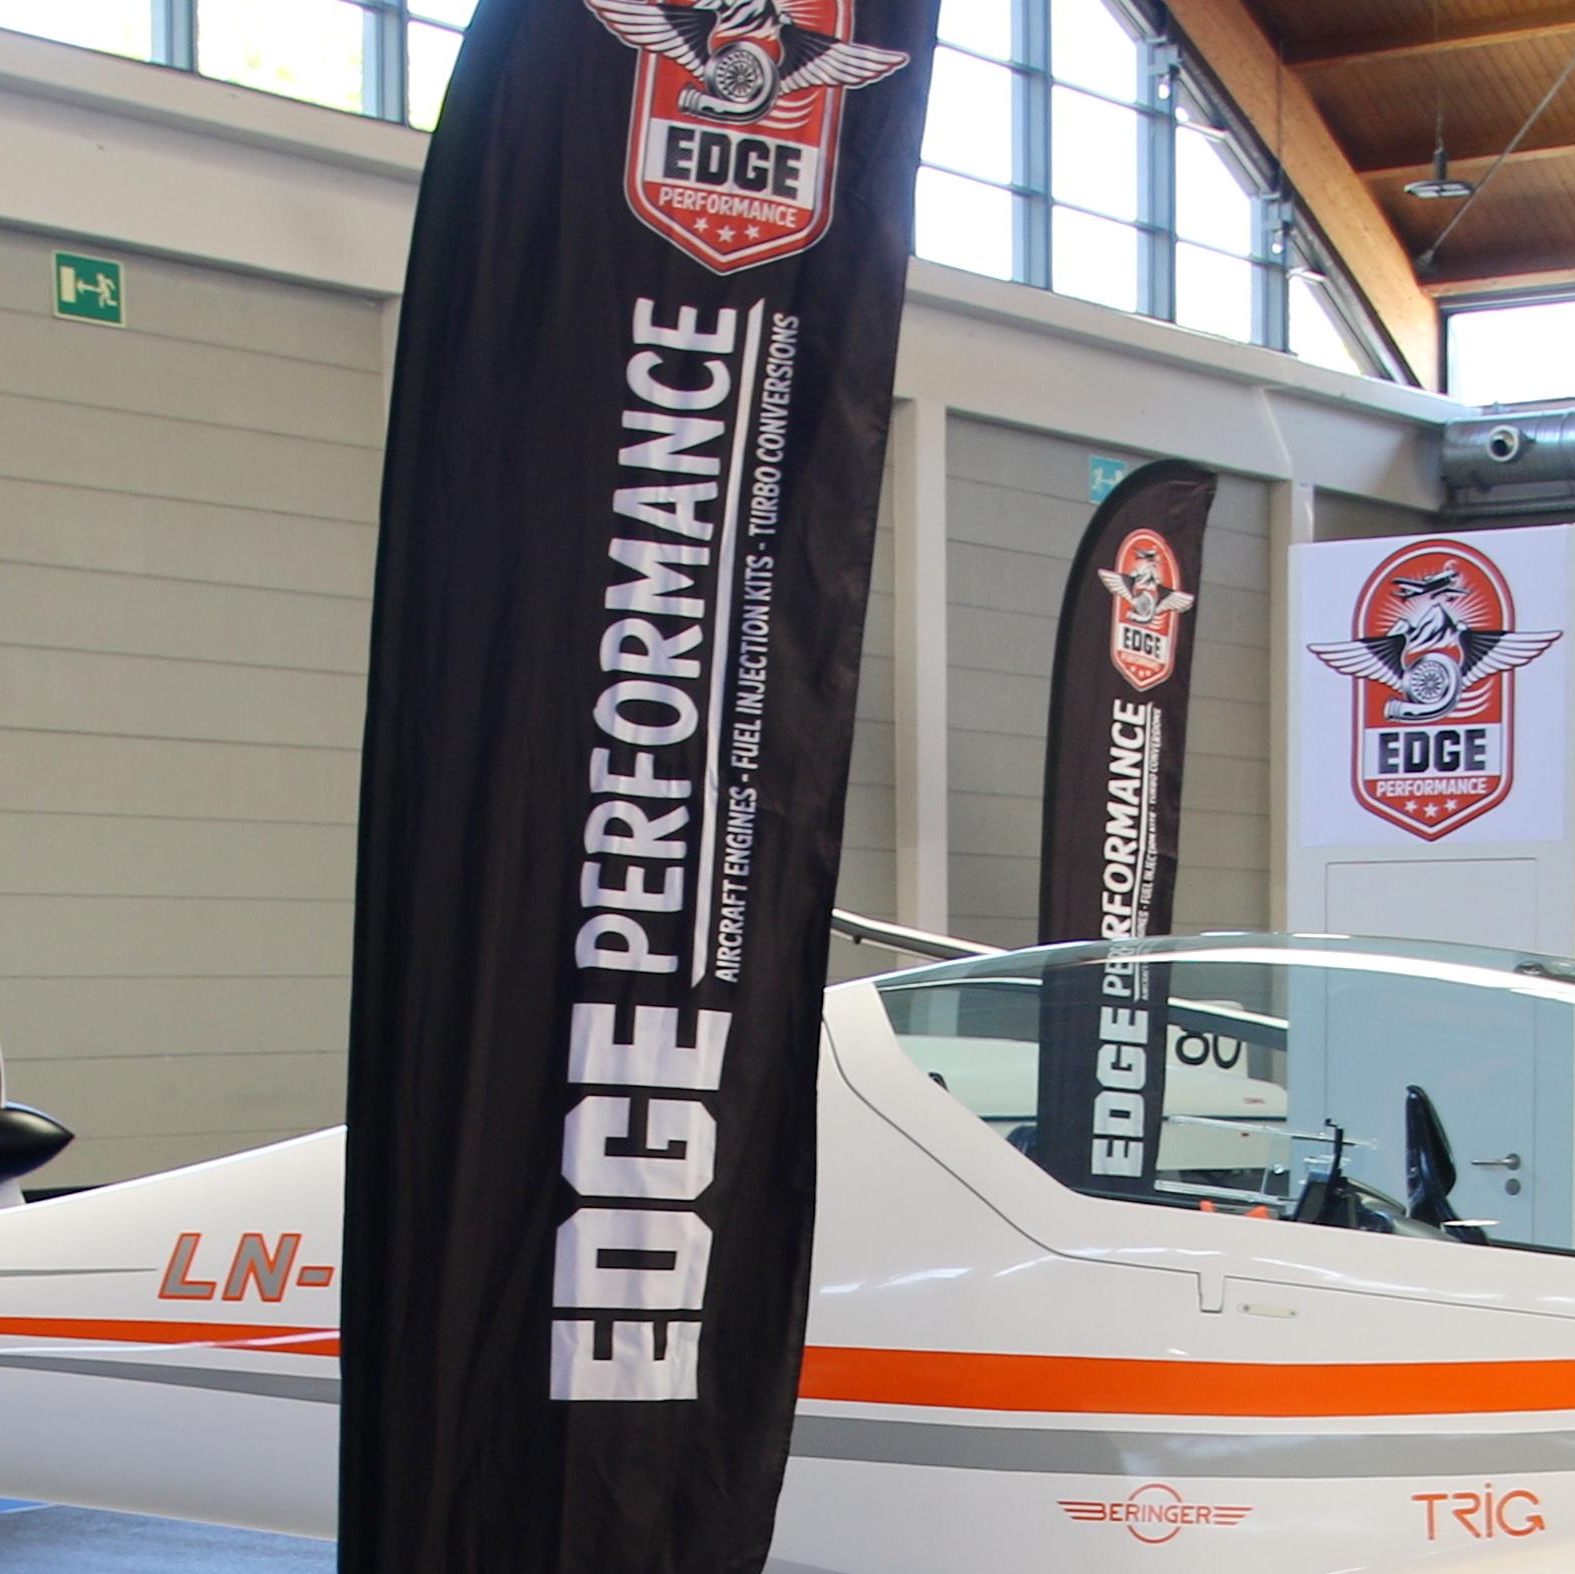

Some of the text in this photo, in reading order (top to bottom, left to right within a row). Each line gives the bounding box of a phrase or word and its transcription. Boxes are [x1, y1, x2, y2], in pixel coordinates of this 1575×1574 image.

[663, 125, 803, 200] EDGE
[659, 189, 798, 229] PERFORMANCE
[756, 312, 799, 464] CONVERSIONS
[749, 466, 781, 536] TURBO
[744, 554, 774, 600] KITS
[735, 605, 770, 716] INJECTION
[1123, 626, 1162, 659] EDGE
[731, 718, 761, 769] FUEL
[1378, 728, 1486, 774] EDGE
[1376, 777, 1487, 797] PERFORMANCE
[550, 297, 737, 1400] EDGE PERFORMANCE
[724, 786, 757, 877] ENGINES
[714, 880, 748, 983] AIRCRAFT
[1091, 1005, 1149, 1178] EDGE
[1089, 1501, 1212, 1526] BERINGER
